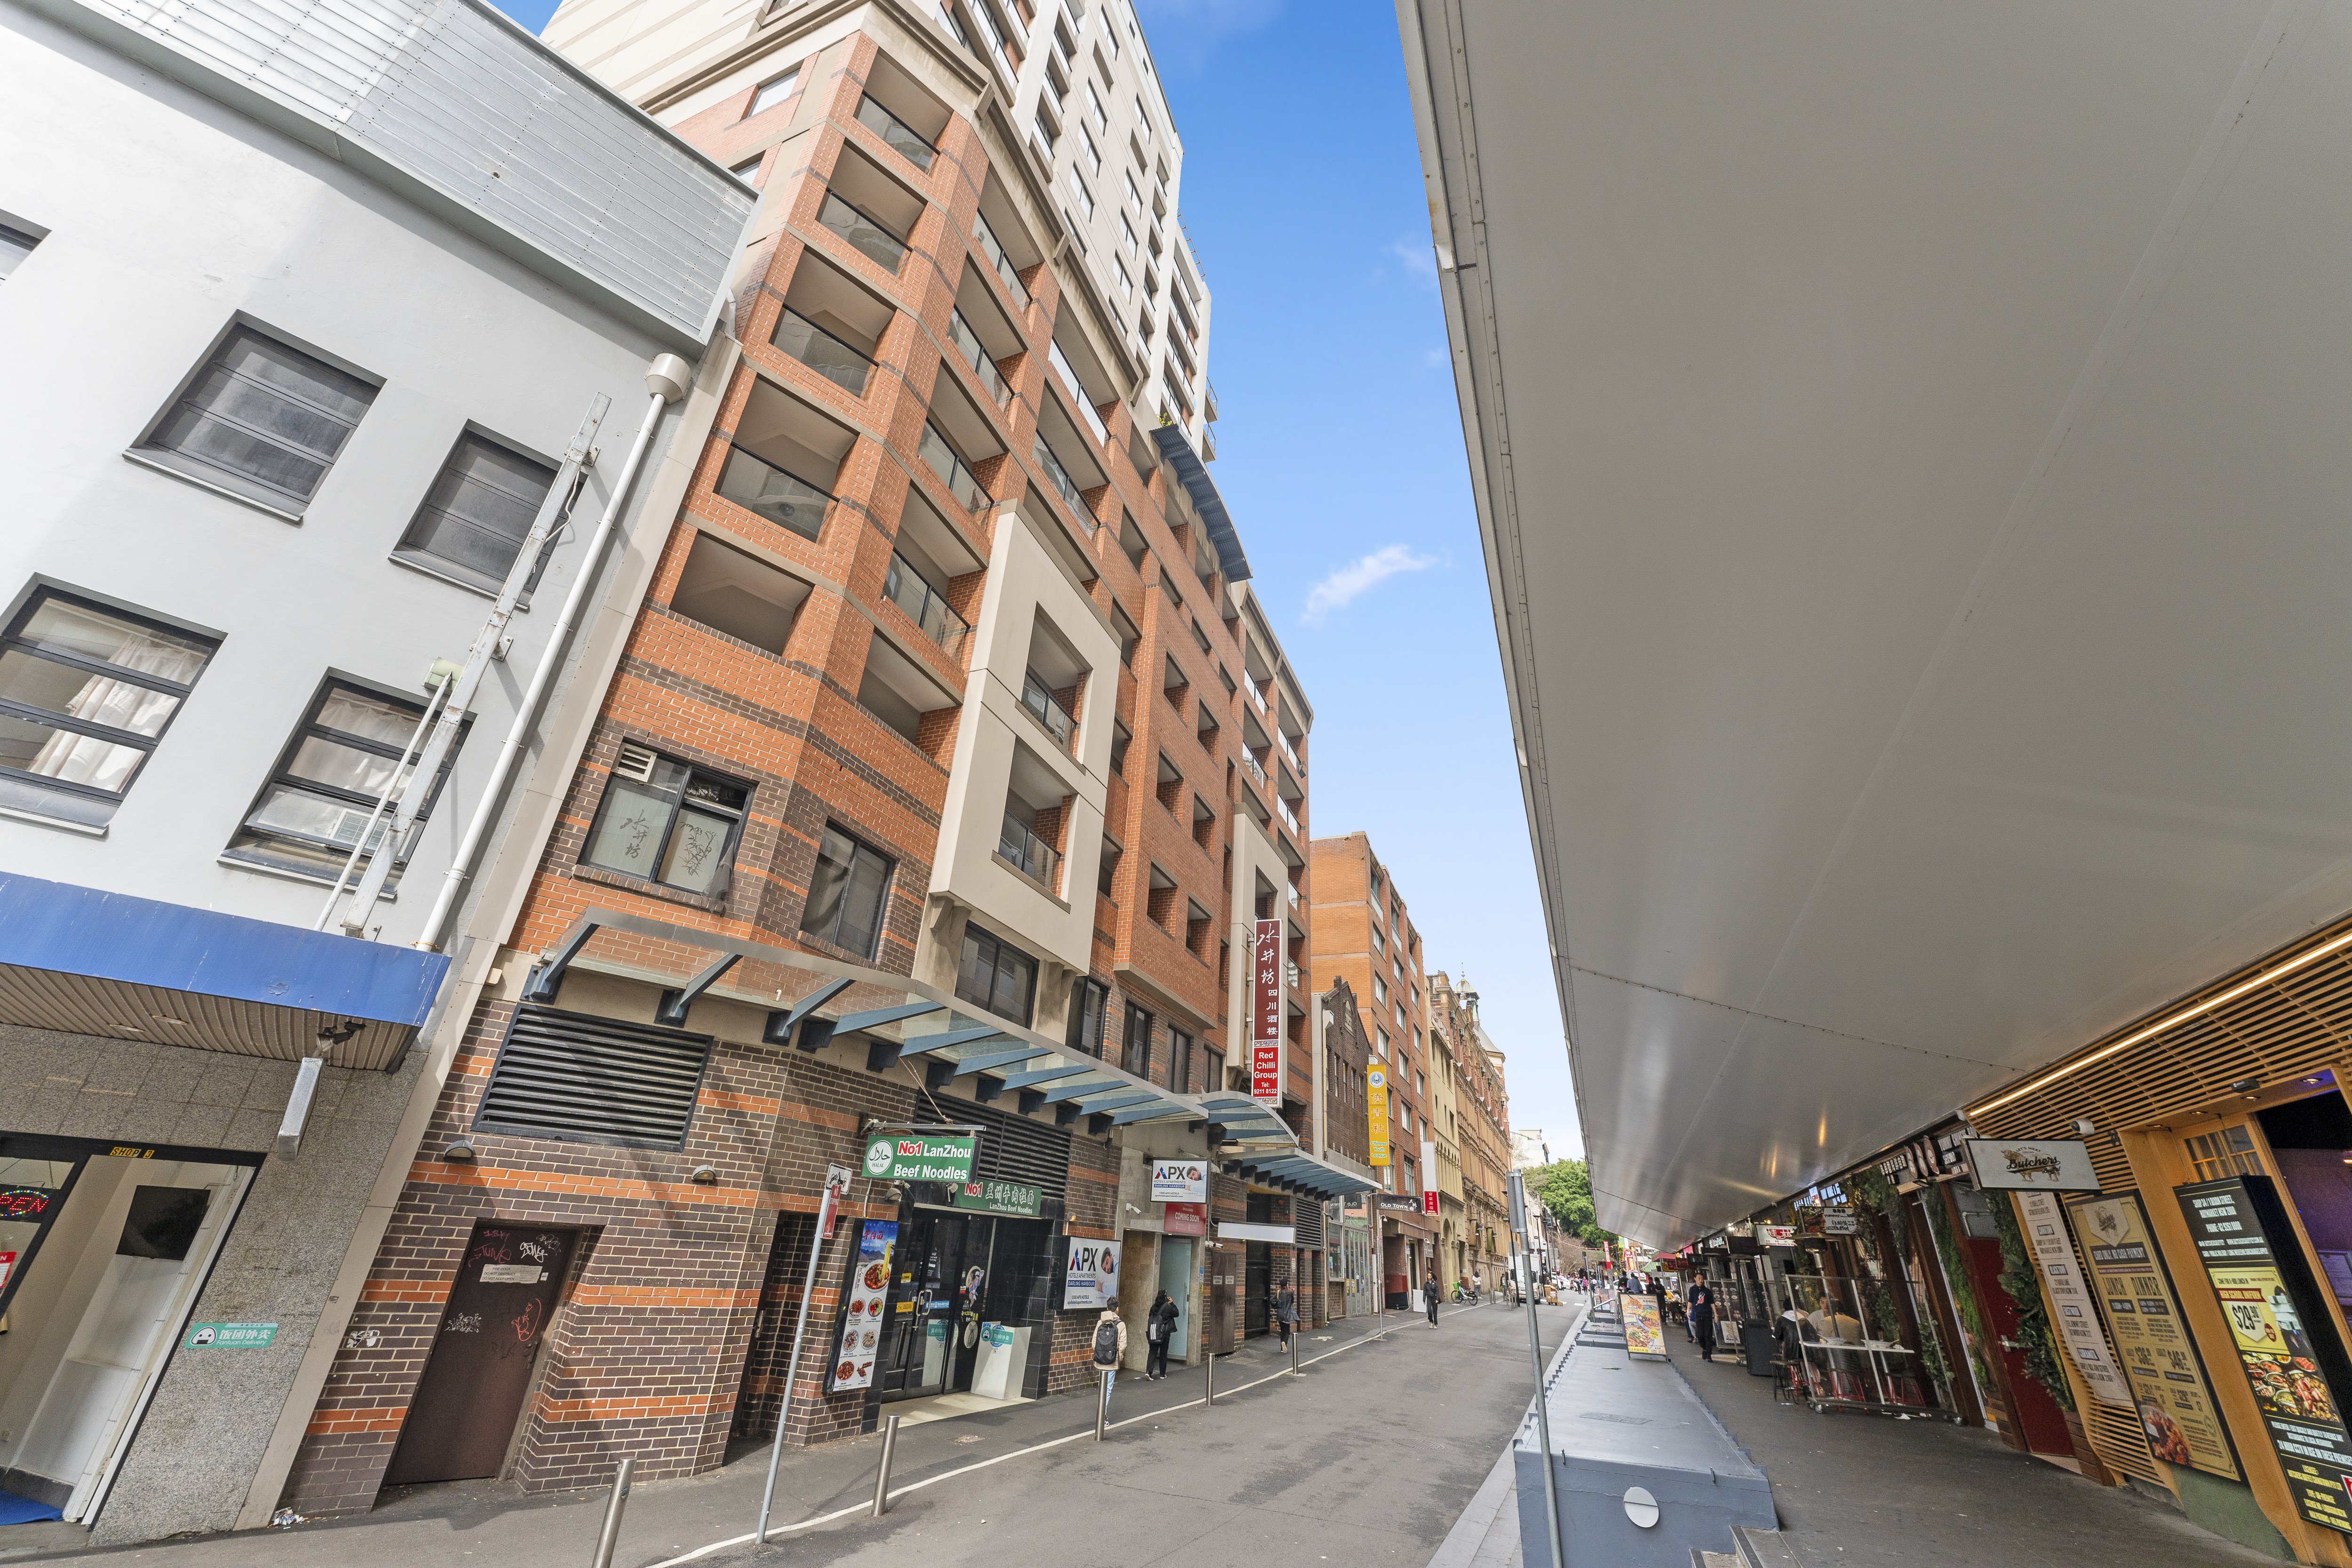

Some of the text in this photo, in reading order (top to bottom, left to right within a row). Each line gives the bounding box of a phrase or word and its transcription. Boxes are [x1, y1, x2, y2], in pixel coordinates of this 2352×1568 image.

[620, 809, 649, 859] 水井坊
[1256, 923, 1279, 984] 水井坊
[1266, 989, 1278, 1035] 四川酒楼
[111, 1148, 140, 1157] SHOP
[869, 1146, 890, 1161] حلال
[898, 1140, 971, 1158] No1 LanZhou
[2006, 1156, 2061, 1170] Butchers
[894, 1164, 967, 1180] Beef Noodles
[1154, 1166, 1186, 1179] APX
[964, 1182, 1035, 1205] No1 兰州牛肉拉面
[0, 1196, 49, 1212] PEN
[990, 1202, 1007, 1211] LanZhou
[1017, 1205, 1033, 1214] Noodles
[1175, 1212, 1200, 1223] COMING SOON
[864, 1230, 884, 1241] 牛肉面
[1069, 1247, 1098, 1272] APX
[2102, 1277, 2163, 1296] LUNCH DINNER
[219, 1329, 271, 1340] 饭团外卖
